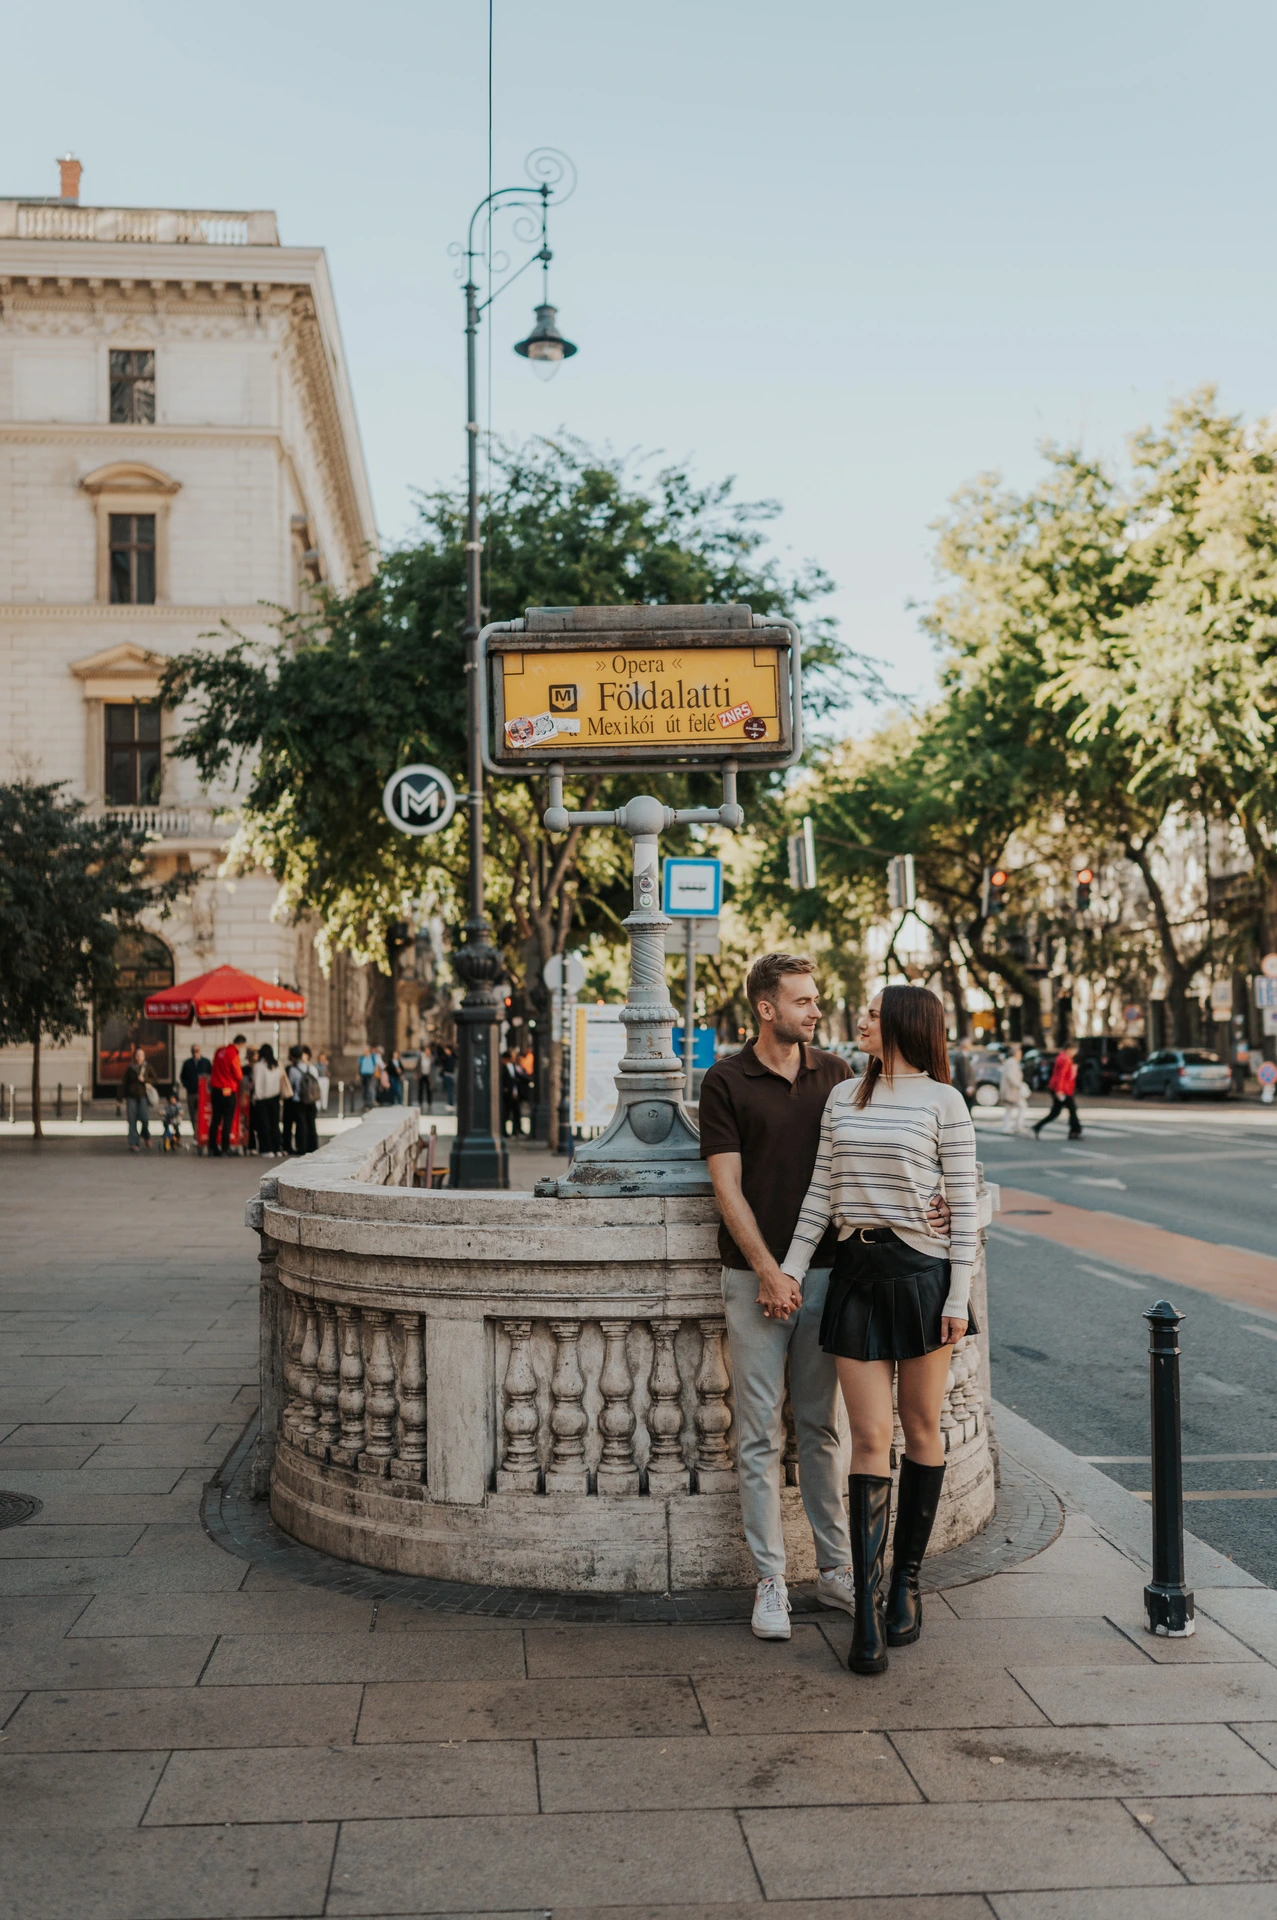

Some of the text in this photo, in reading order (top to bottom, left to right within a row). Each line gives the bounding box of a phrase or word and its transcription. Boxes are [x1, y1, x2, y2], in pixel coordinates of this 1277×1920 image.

[612, 655, 664, 678] Opera
[555, 690, 571, 702] M
[598, 678, 732, 711] Földalatti
[588, 713, 716, 736] Mexikói út felé
[718, 703, 752, 728] ZNRS
[401, 781, 438, 818] M
